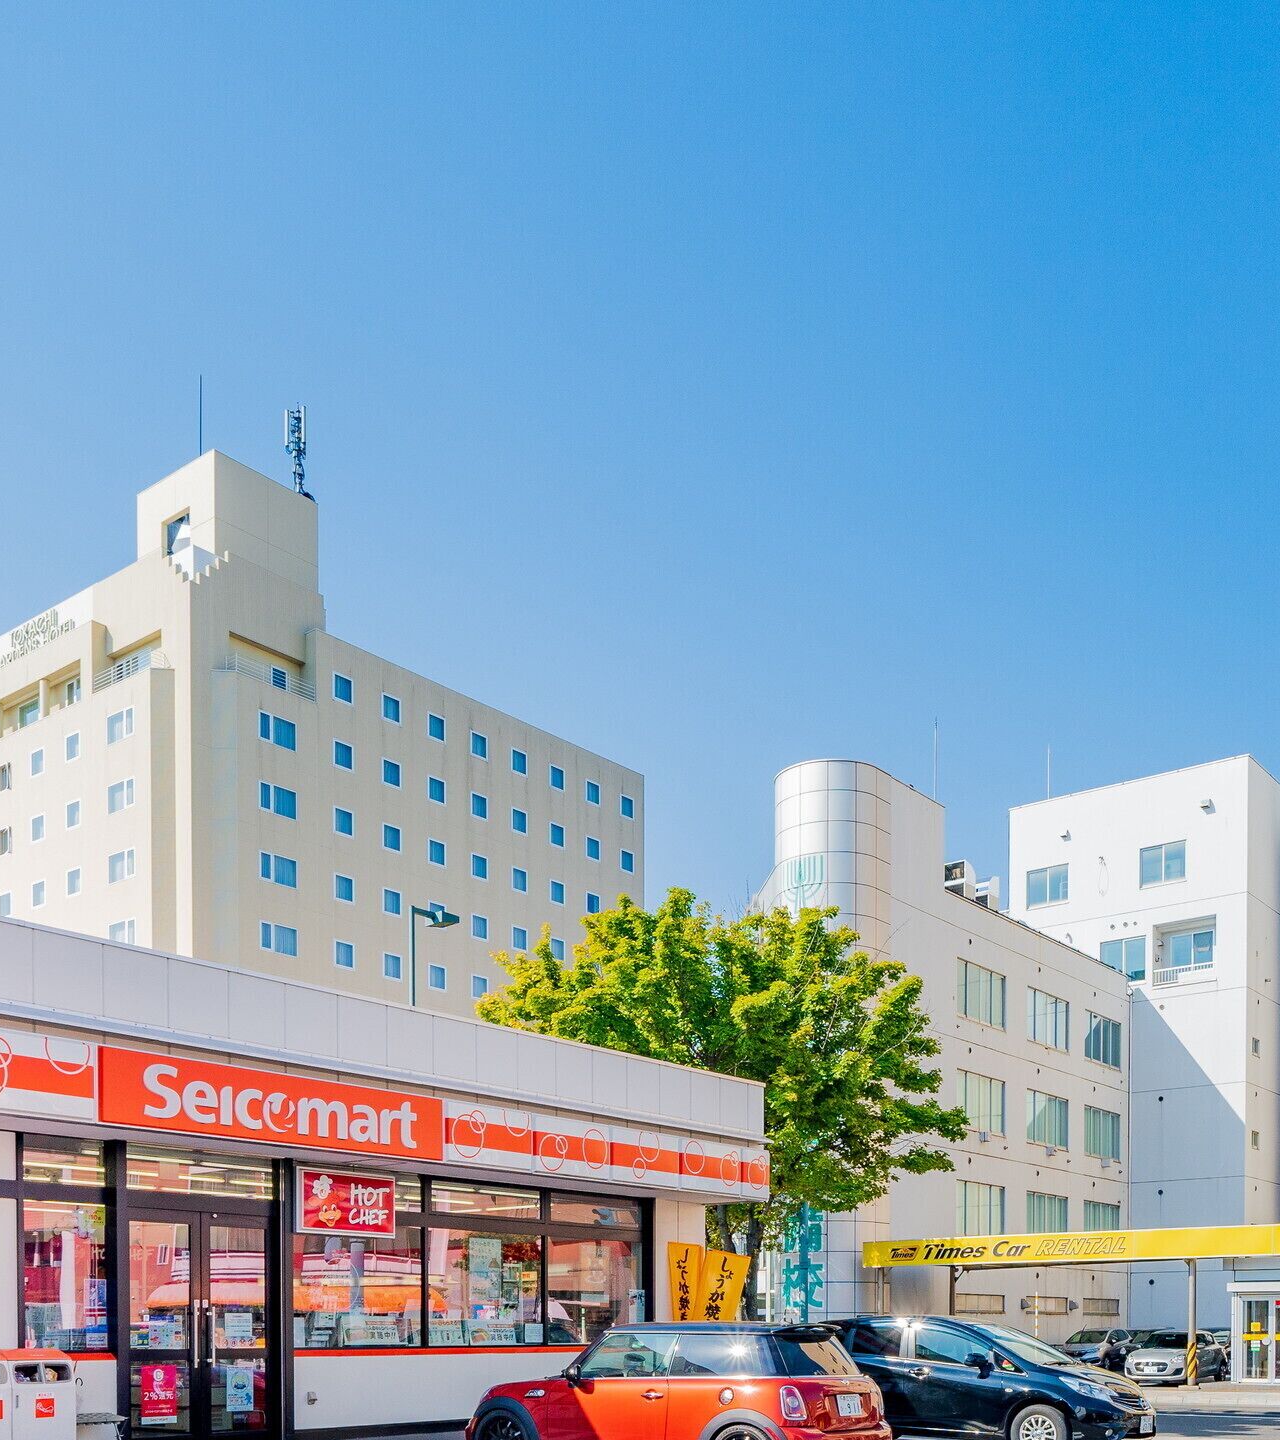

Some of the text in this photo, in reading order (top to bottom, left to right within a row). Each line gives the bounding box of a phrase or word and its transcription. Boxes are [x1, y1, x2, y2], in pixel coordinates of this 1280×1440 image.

[142, 1063, 418, 1149] Seicomart
[349, 1182, 390, 1208] HOT
[348, 1207, 389, 1226] CHEF
[890, 1236, 1127, 1261] Times Times Car RENTAL
